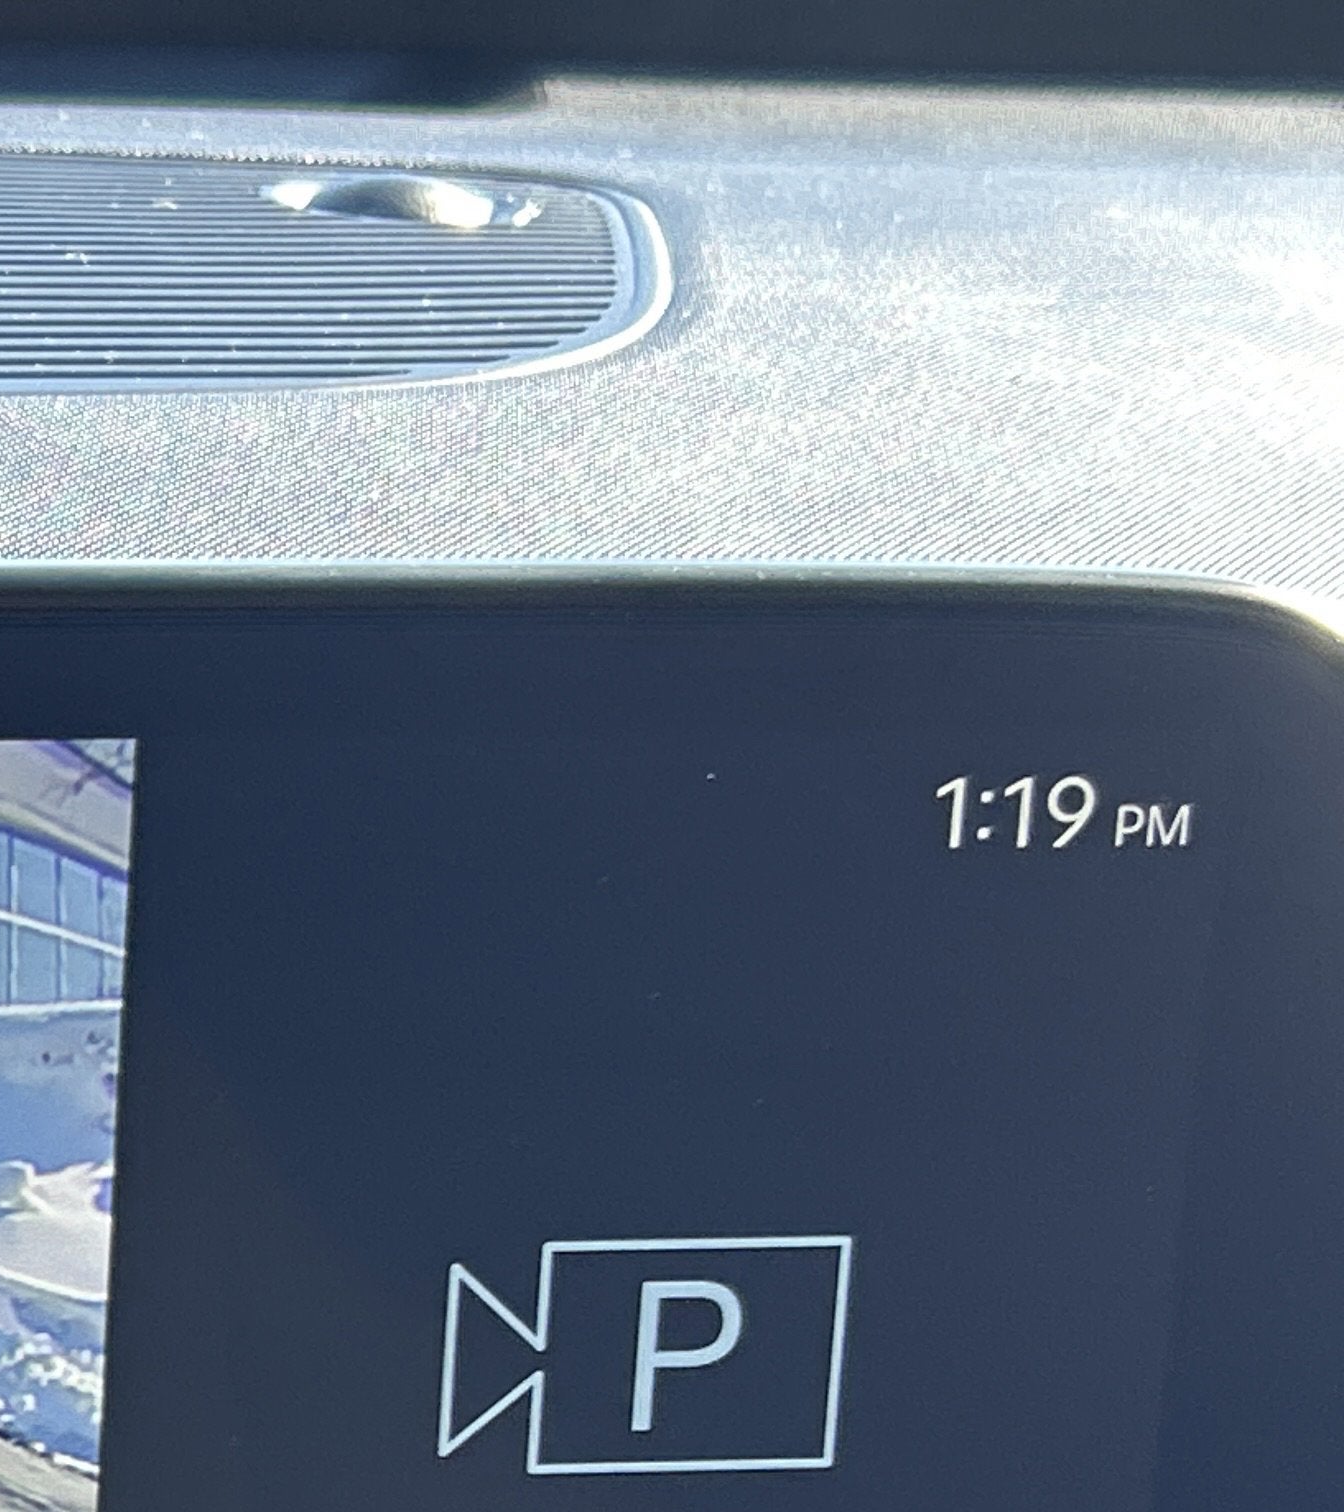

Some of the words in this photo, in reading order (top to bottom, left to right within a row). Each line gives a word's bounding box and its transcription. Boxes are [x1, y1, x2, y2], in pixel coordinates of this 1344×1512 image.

[935, 775, 1097, 849] 1:19
[1114, 803, 1193, 848] PM
[630, 1280, 743, 1432] P
